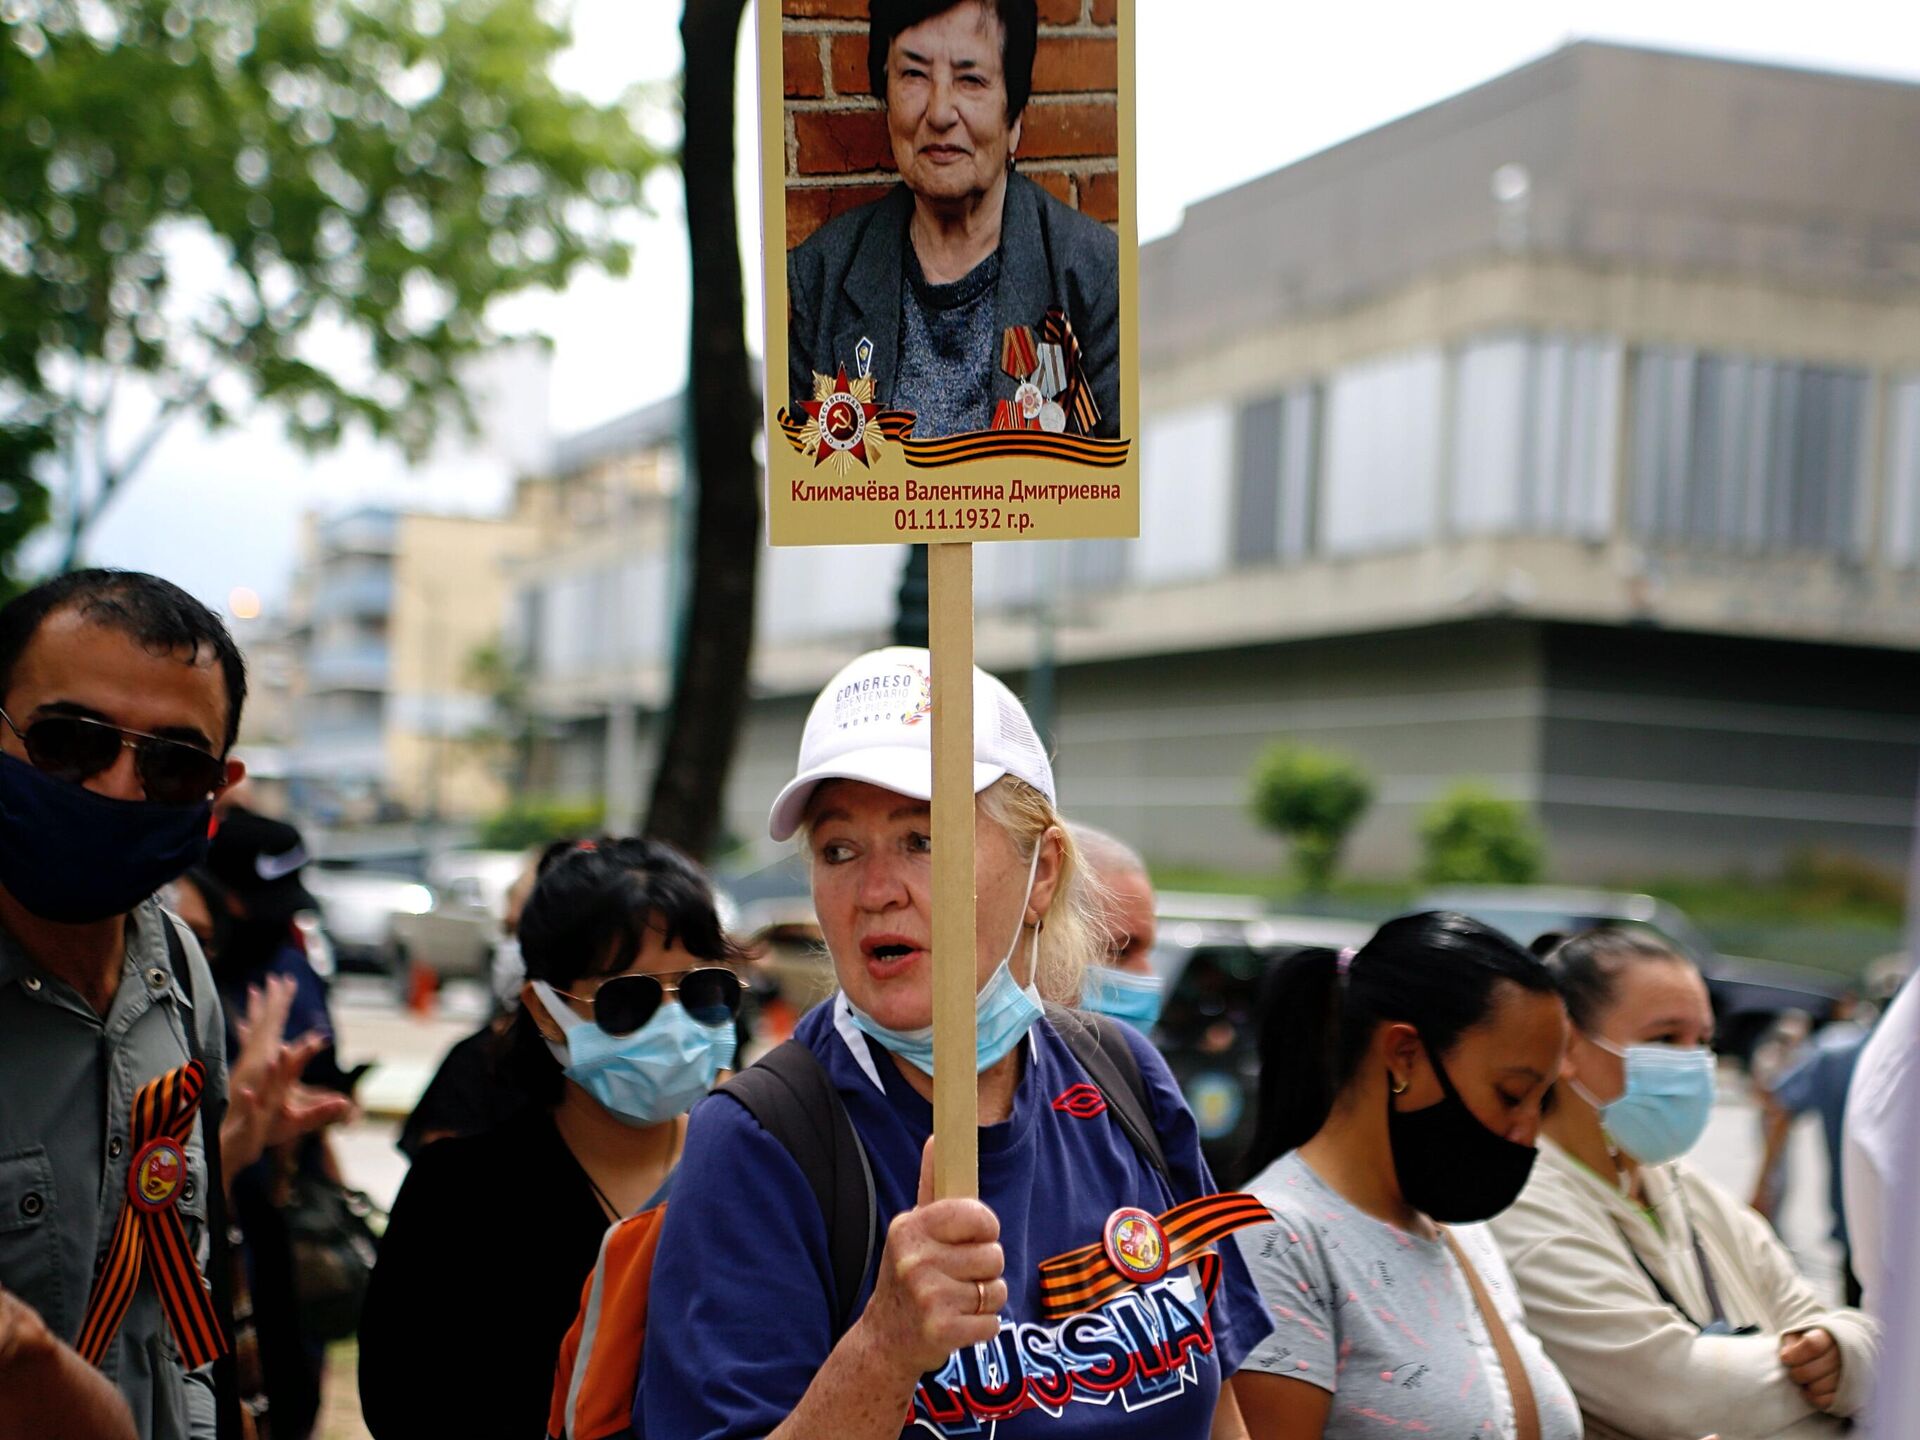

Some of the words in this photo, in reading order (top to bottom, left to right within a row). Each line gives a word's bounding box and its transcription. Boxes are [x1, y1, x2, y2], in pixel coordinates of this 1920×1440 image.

[791, 480, 900, 502] Климачёва
[906, 480, 1005, 502] Валентина
[1009, 480, 1121, 505] Дмитриевна
[894, 508, 1001, 531] 01.11.1932
[1007, 513, 1036, 534] г.р.
[836, 675, 912, 702] CONGRESO
